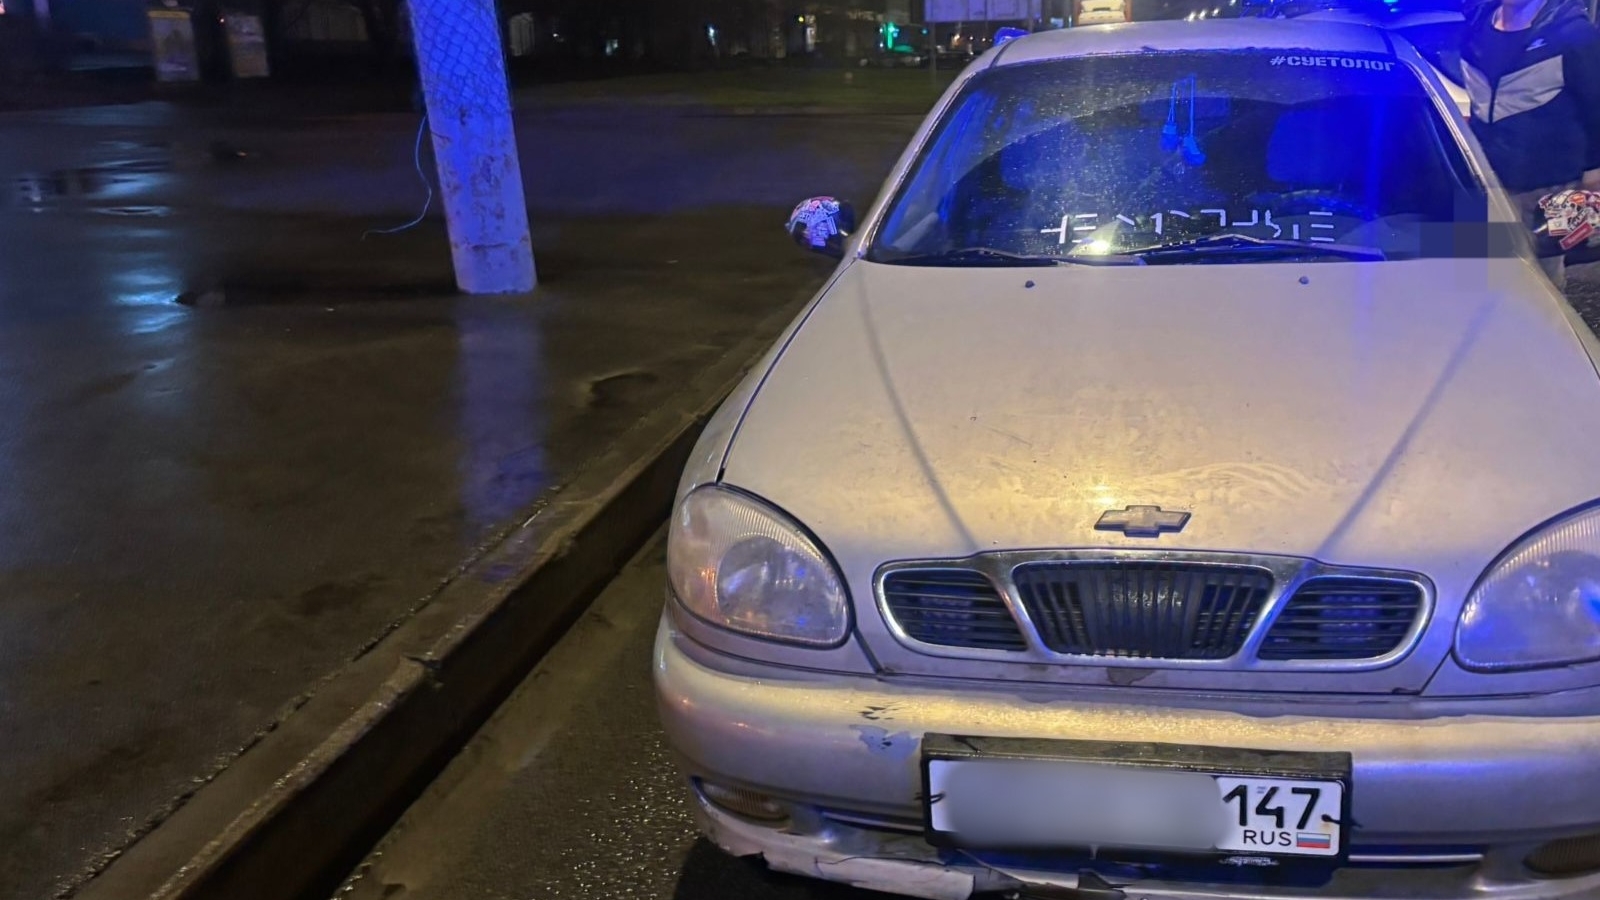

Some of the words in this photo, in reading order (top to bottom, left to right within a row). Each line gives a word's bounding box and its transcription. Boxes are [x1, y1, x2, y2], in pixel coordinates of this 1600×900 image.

[1270, 55, 1395, 72] #СУЕТОЛОГ
[1222, 784, 1321, 830] 147
[1243, 829, 1292, 847] RUS
